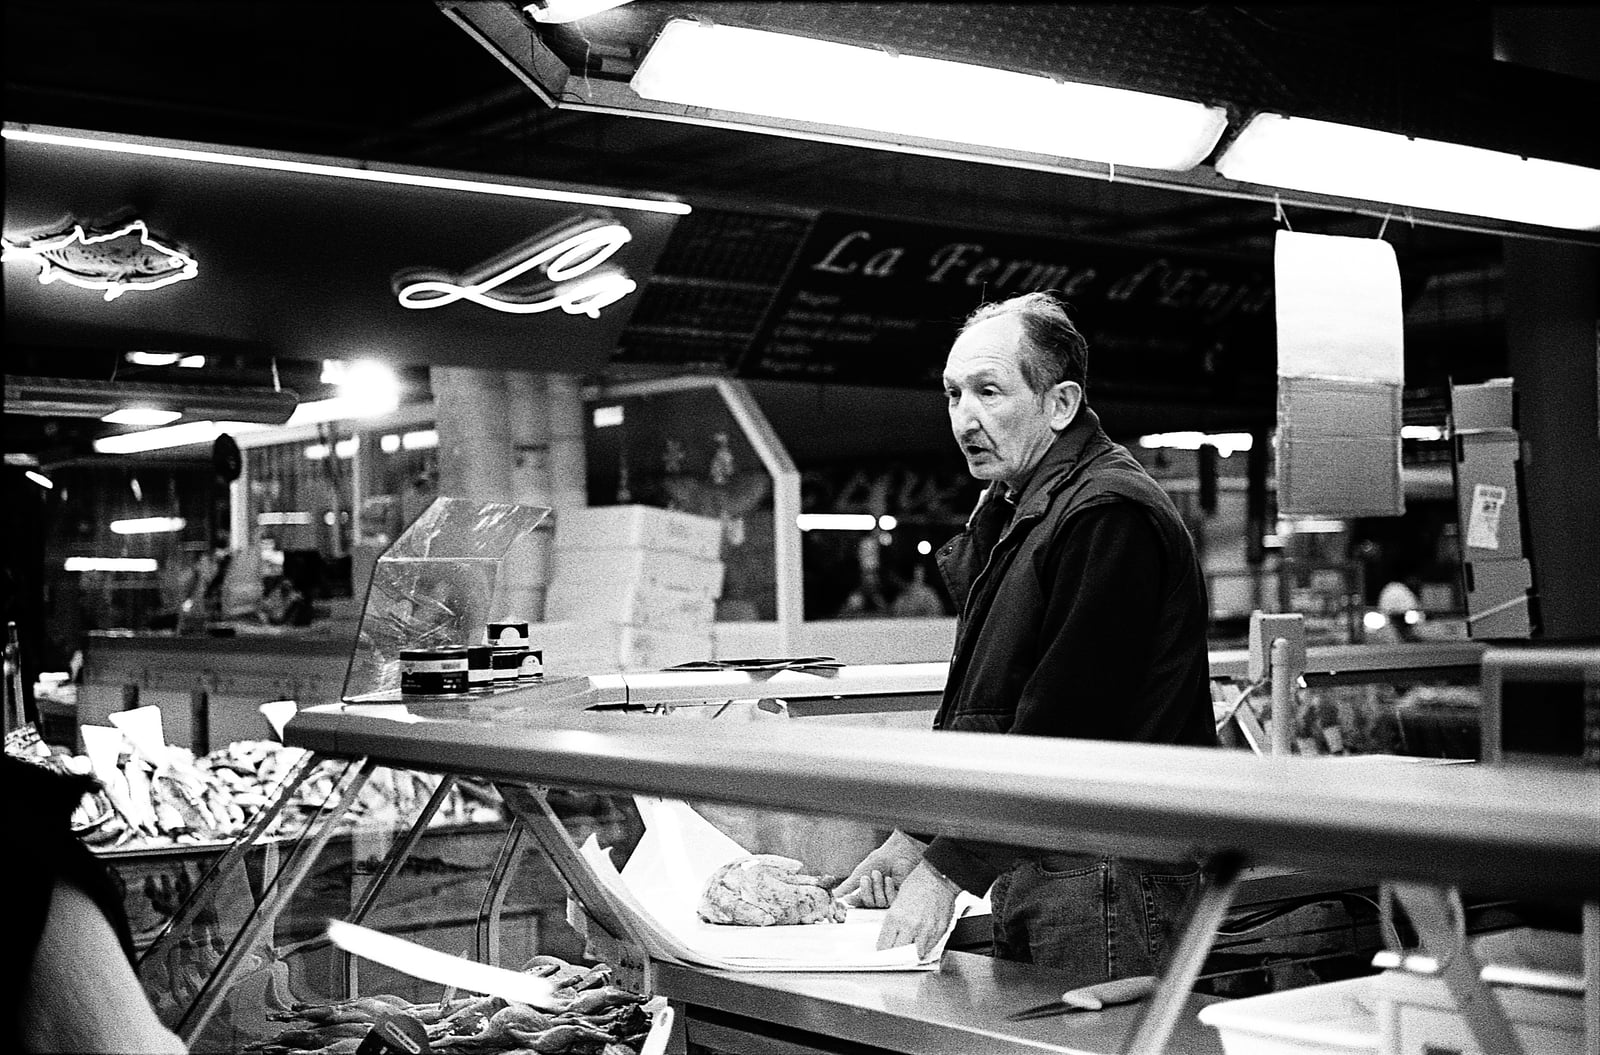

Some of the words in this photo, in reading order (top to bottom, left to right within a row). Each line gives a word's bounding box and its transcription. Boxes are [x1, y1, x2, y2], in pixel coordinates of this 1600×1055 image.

[398, 224, 637, 319] La
[811, 229, 905, 277] La
[926, 242, 1097, 296] Ferme
